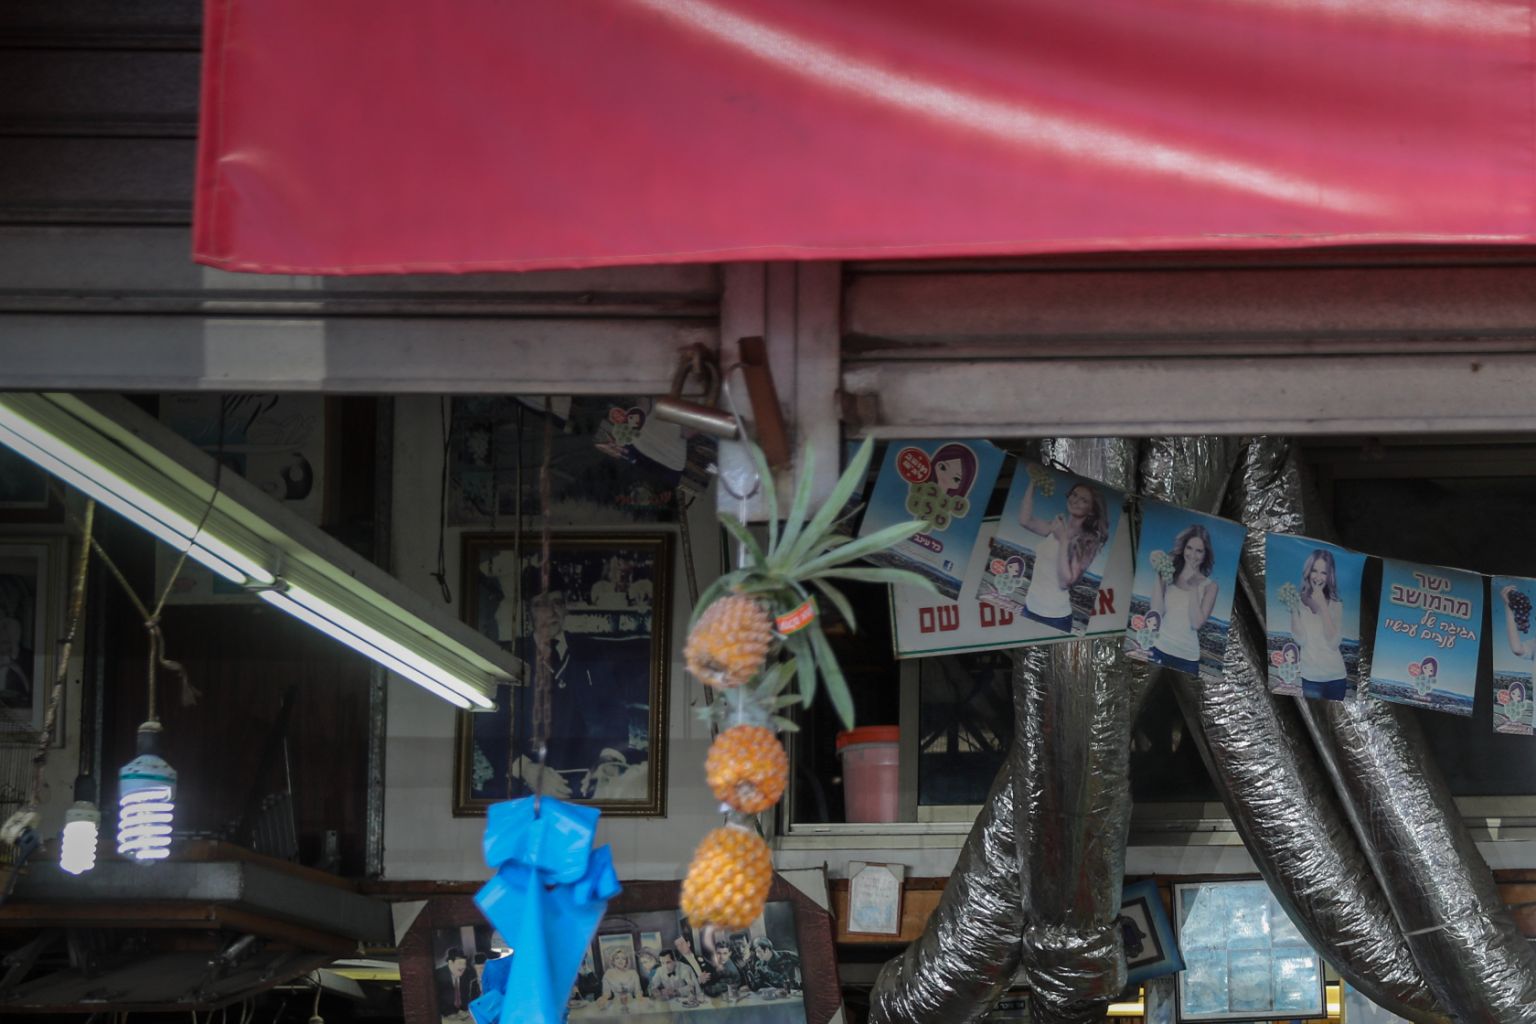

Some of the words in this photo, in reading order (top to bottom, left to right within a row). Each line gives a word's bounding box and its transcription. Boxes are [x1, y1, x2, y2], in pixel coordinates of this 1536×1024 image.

[1415, 573, 1449, 590] ישר
[1392, 585, 1469, 617] מהמושב
[919, 605, 960, 633] שם
[1421, 610, 1437, 628] של
[1421, 630, 1456, 648] ענבים
[1440, 621, 1476, 640] חגיגה
